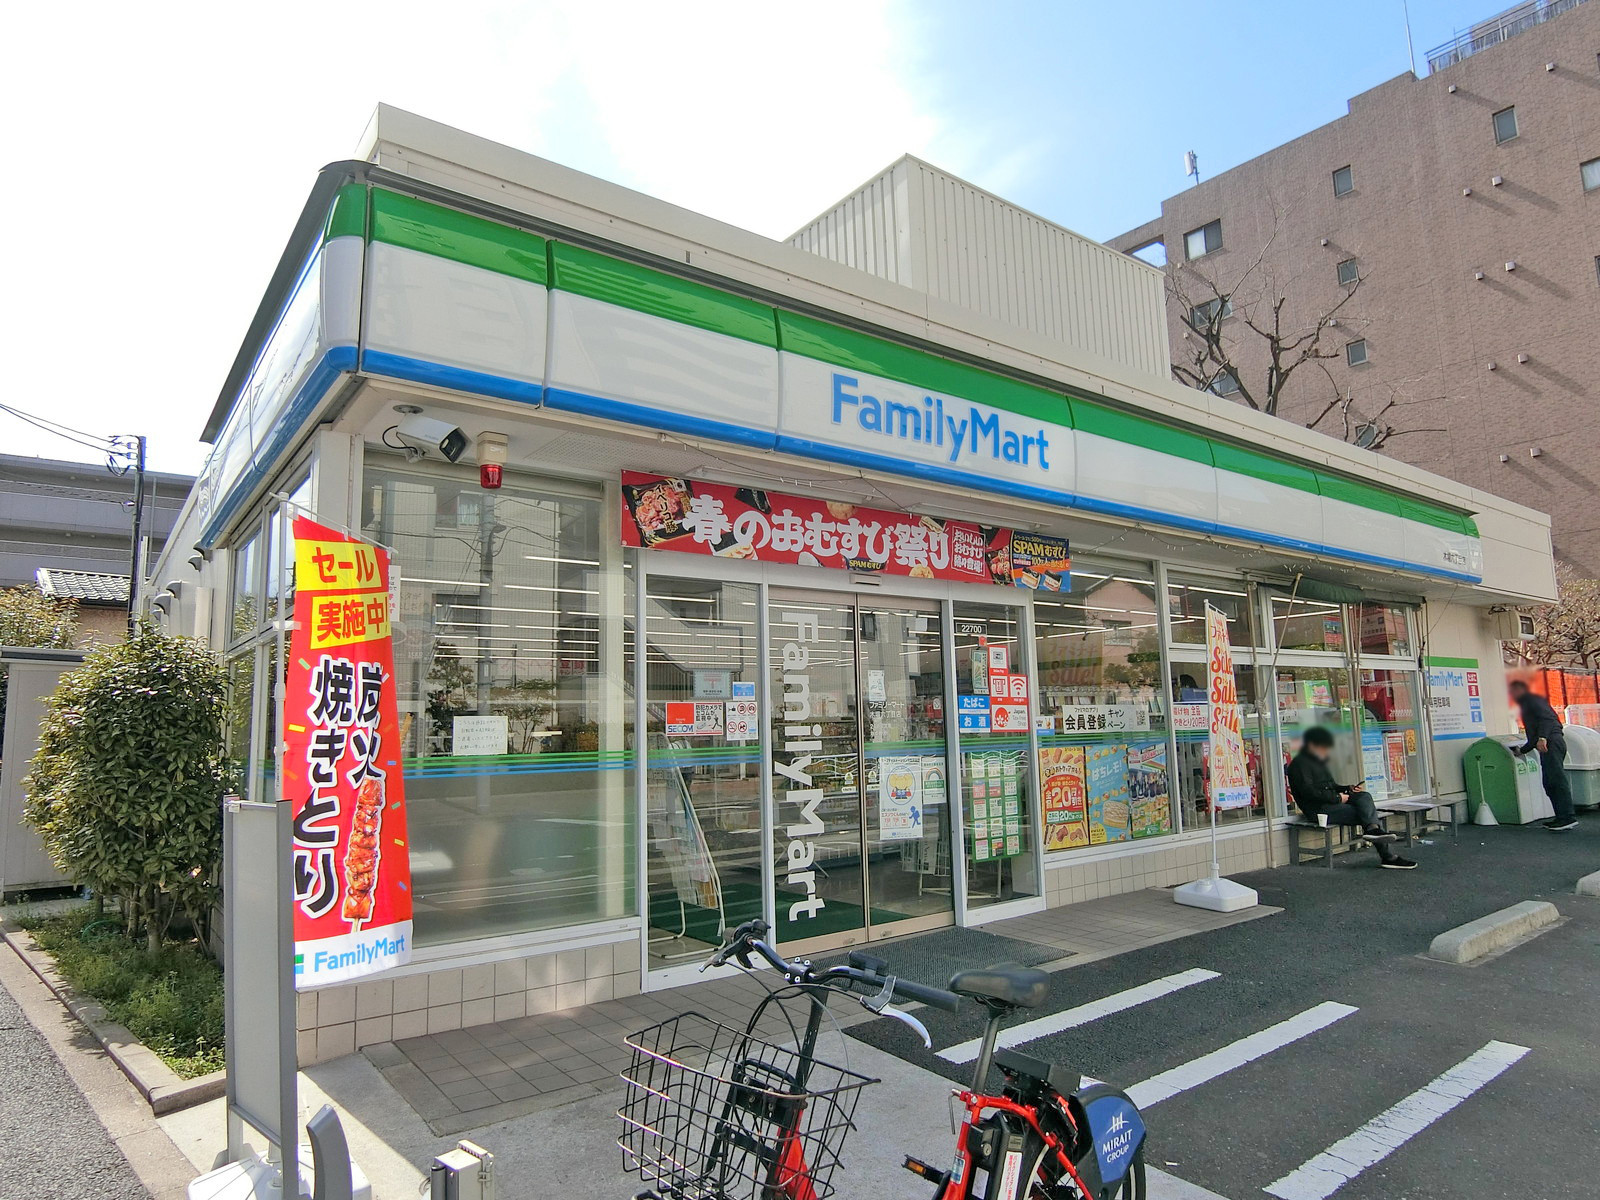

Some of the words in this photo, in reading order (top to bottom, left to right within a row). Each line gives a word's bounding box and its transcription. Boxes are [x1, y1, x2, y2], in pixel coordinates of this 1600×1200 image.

[831, 372, 1049, 470] FamilyMart
[682, 494, 949, 570] 春のおむすび祭り
[954, 543, 983, 559] おむすび
[311, 547, 375, 584] セール
[961, 624, 982, 633] 22700
[869, 701, 905, 709] ファミリーマート
[964, 697, 985, 708] たばこ
[350, 656, 386, 786] 炭火
[964, 716, 986, 727] お酒
[1065, 714, 1107, 730] 会員登録
[1108, 709, 1125, 718] キャン
[1107, 721, 1126, 730] ペーン
[775, 611, 825, 922] FamilyMart
[293, 658, 354, 914] 焼きとり
[1052, 786, 1071, 808] 20
[313, 935, 405, 972] FamilyMart
[1102, 1129, 1133, 1155] MIRAIT
[1106, 1144, 1129, 1163] GROUP
